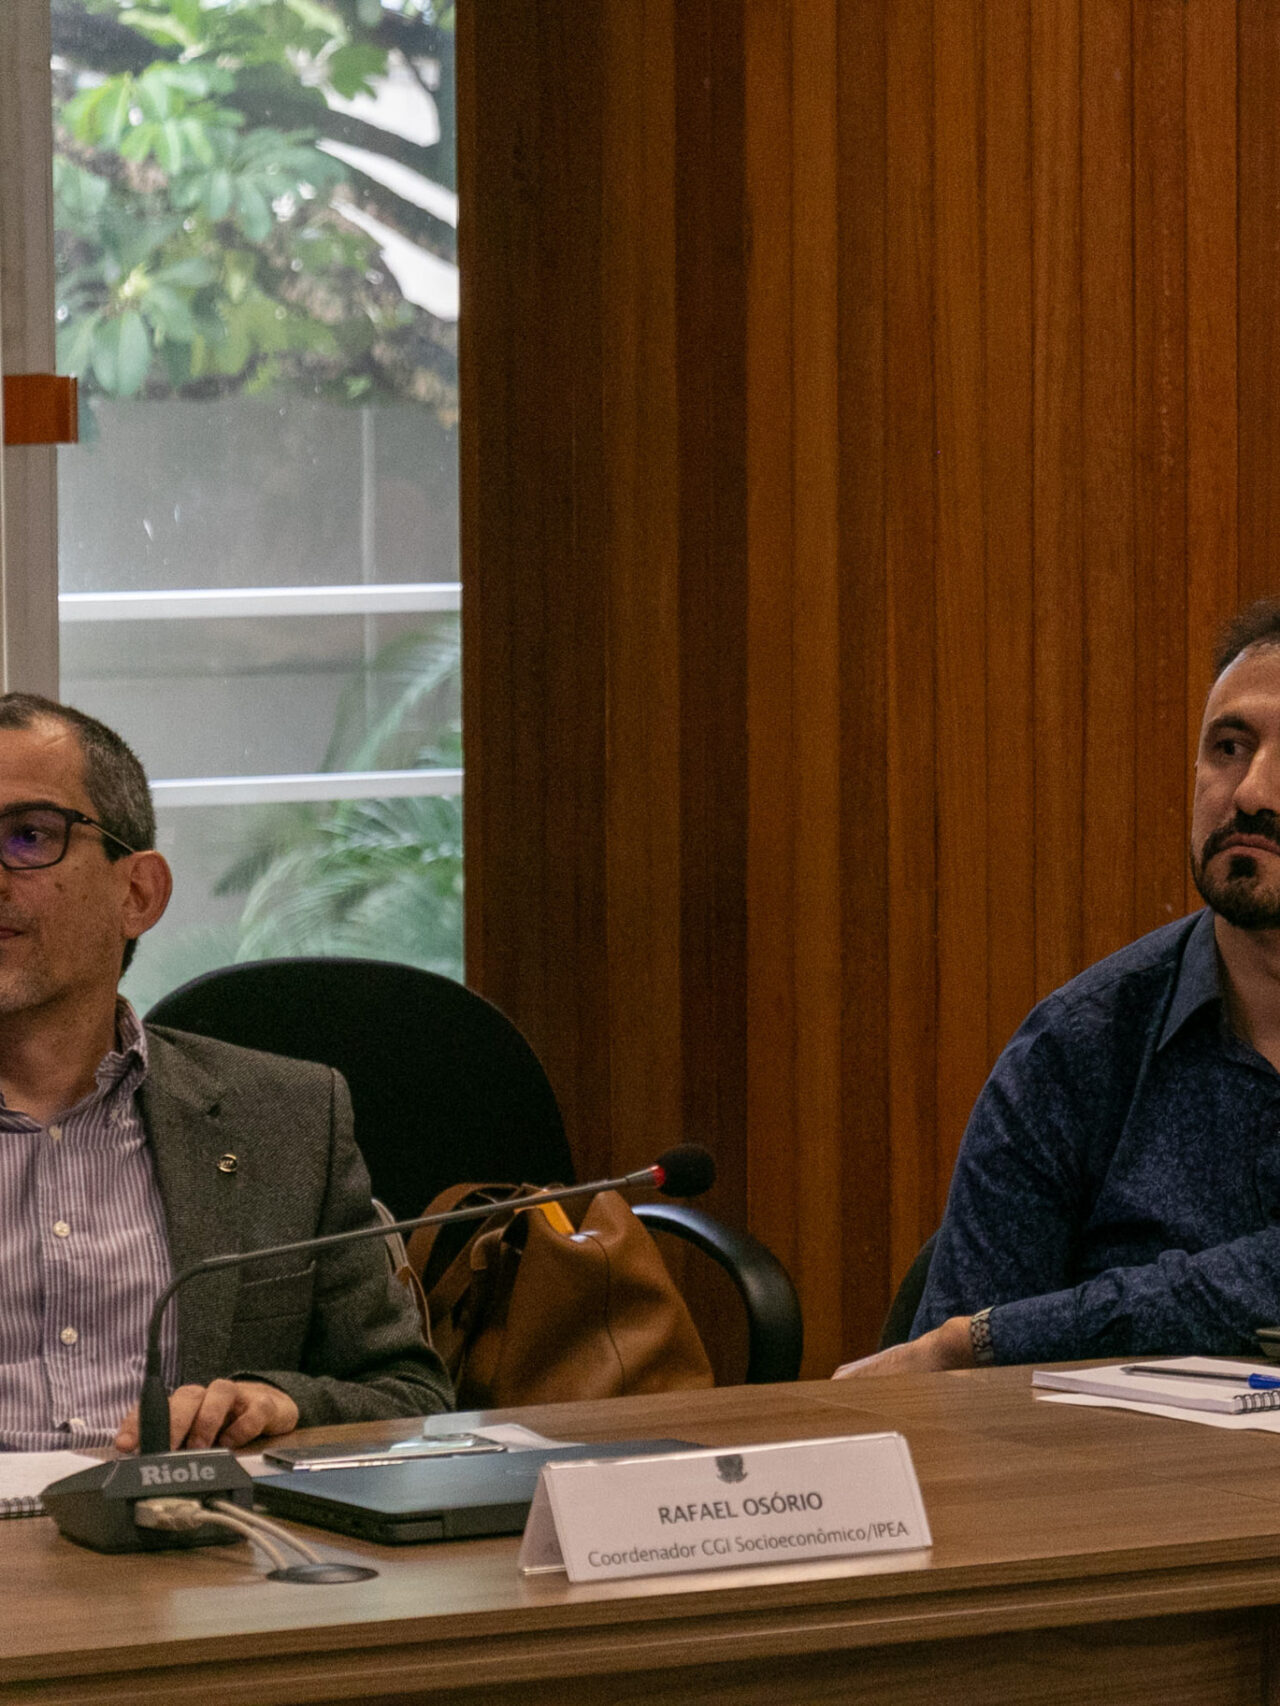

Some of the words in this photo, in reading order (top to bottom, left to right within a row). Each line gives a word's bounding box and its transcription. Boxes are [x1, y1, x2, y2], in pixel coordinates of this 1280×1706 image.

[138, 1462, 216, 1487] Riole
[657, 1501, 739, 1525] RAFAEL
[742, 1491, 823, 1517] OSÓRIO
[587, 1542, 697, 1568] Coordenador
[701, 1536, 732, 1556] CGI
[734, 1520, 909, 1553] Socioeconômico/IPEA
